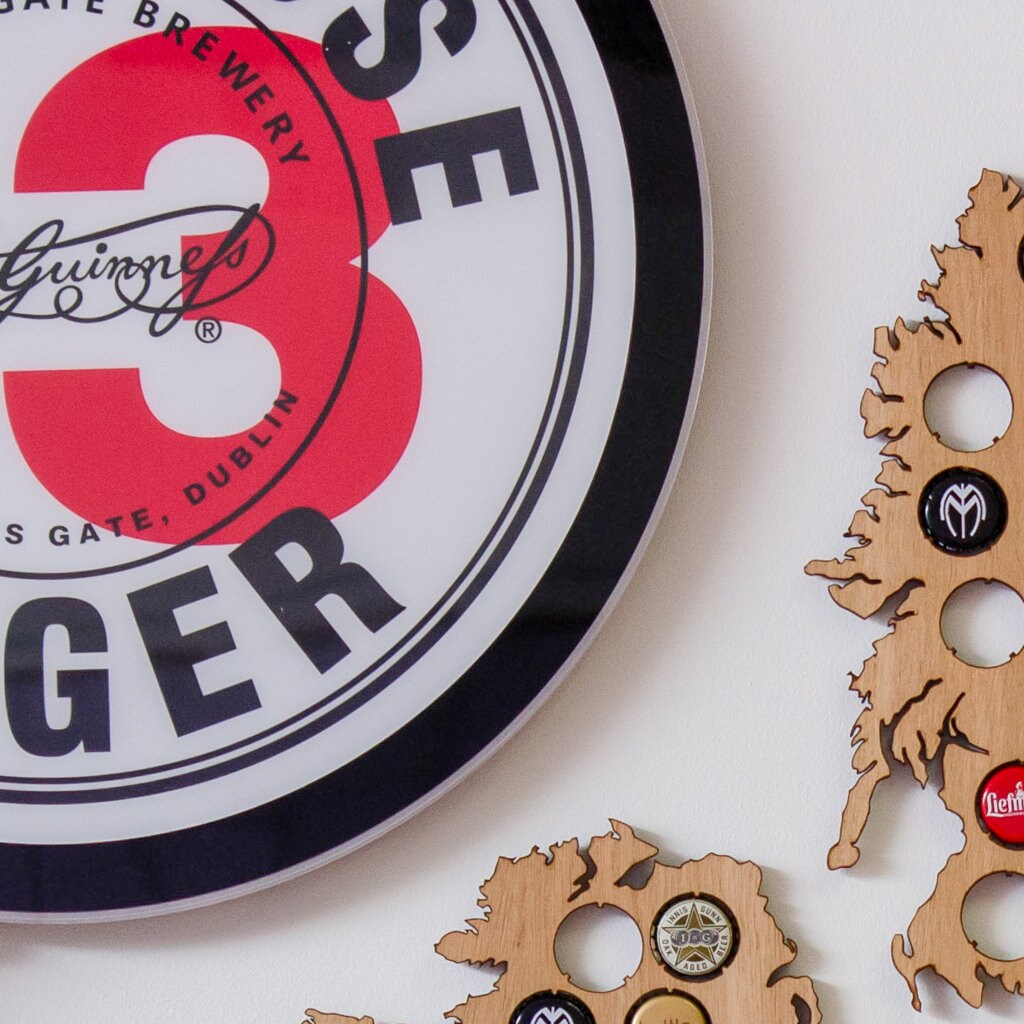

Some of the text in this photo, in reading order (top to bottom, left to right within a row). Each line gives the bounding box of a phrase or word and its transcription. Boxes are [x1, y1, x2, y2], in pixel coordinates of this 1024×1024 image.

[133, 0, 310, 165] BREWERY
[274, 0, 540, 226] SE
[5, 388, 299, 546] S GATE, DUBLIN
[4, 506, 407, 757] GER
[661, 934, 728, 971] OAK AGED BEER
[666, 905, 688, 924] INNIS
[700, 905, 721, 923] GUNN
